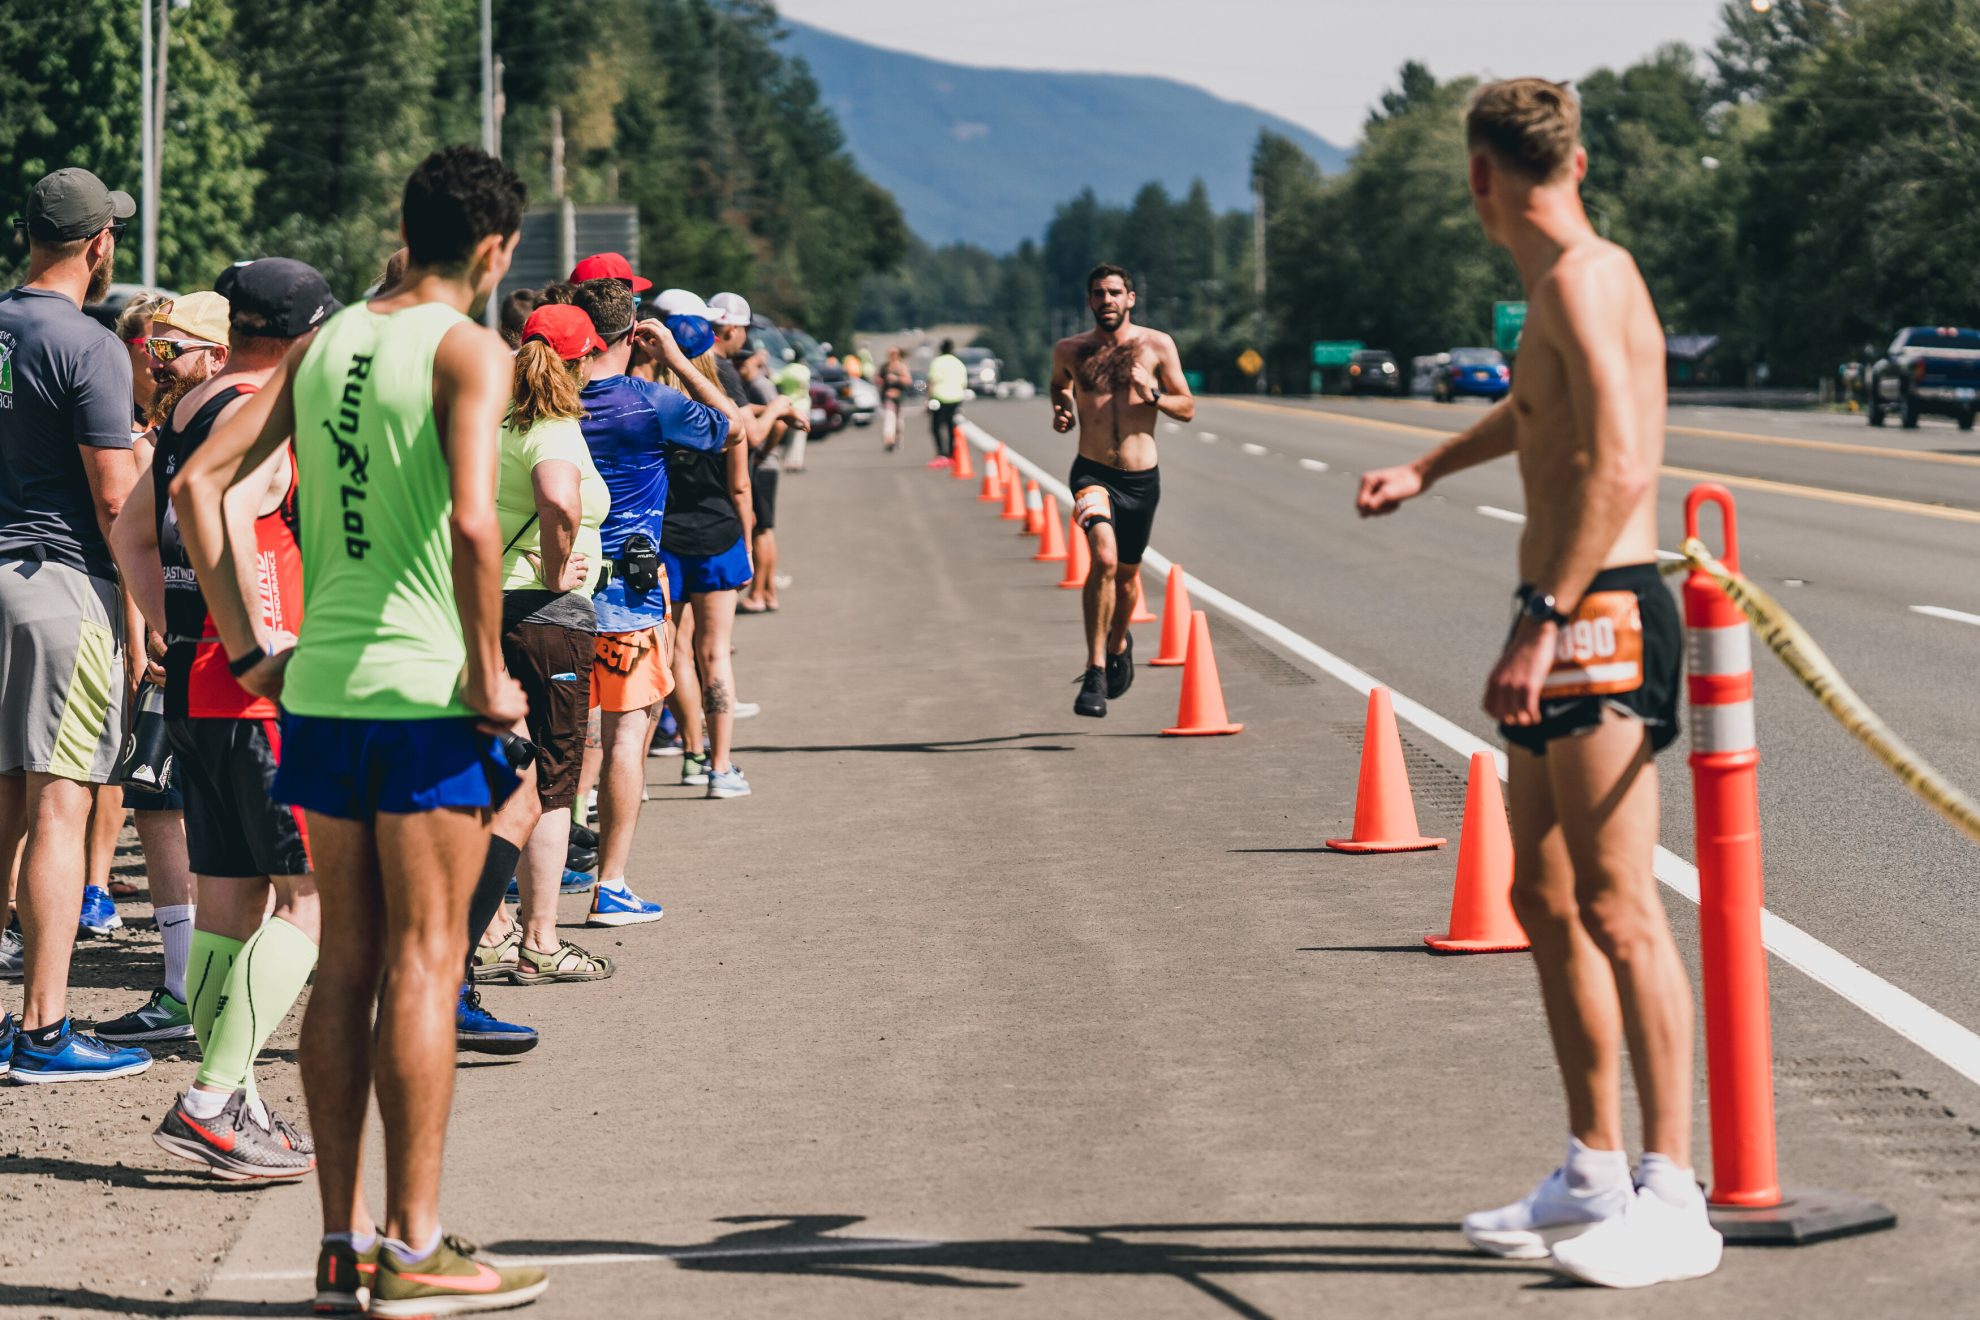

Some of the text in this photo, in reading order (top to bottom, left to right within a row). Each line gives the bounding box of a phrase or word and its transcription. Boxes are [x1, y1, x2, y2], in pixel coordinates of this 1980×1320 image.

[338, 351, 374, 561] Run Lab
[268, 550, 283, 622] ENDURANCE
